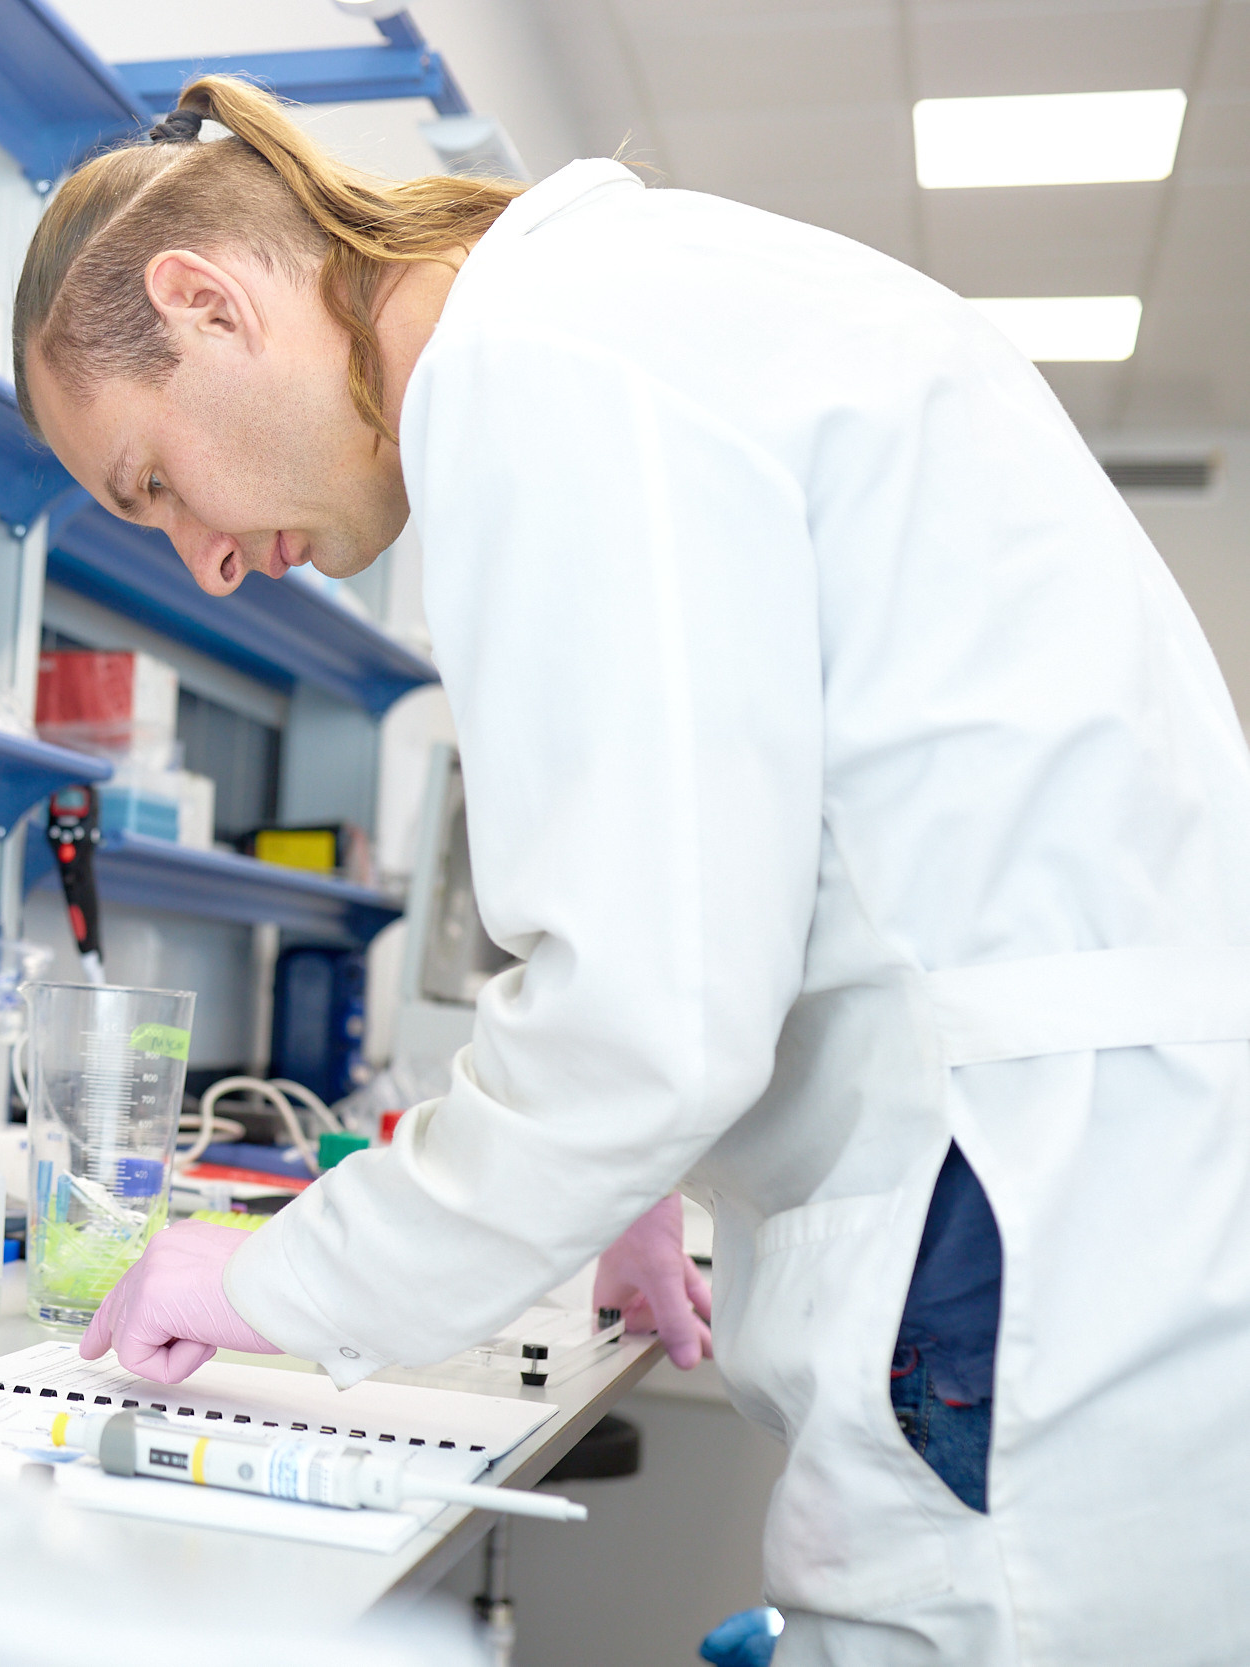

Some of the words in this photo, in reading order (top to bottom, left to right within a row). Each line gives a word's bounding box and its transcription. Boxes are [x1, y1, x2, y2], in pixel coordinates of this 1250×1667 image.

[142, 1073, 158, 1083] 800
[141, 1095, 155, 1105] 700
[134, 1170, 148, 1179] 400
